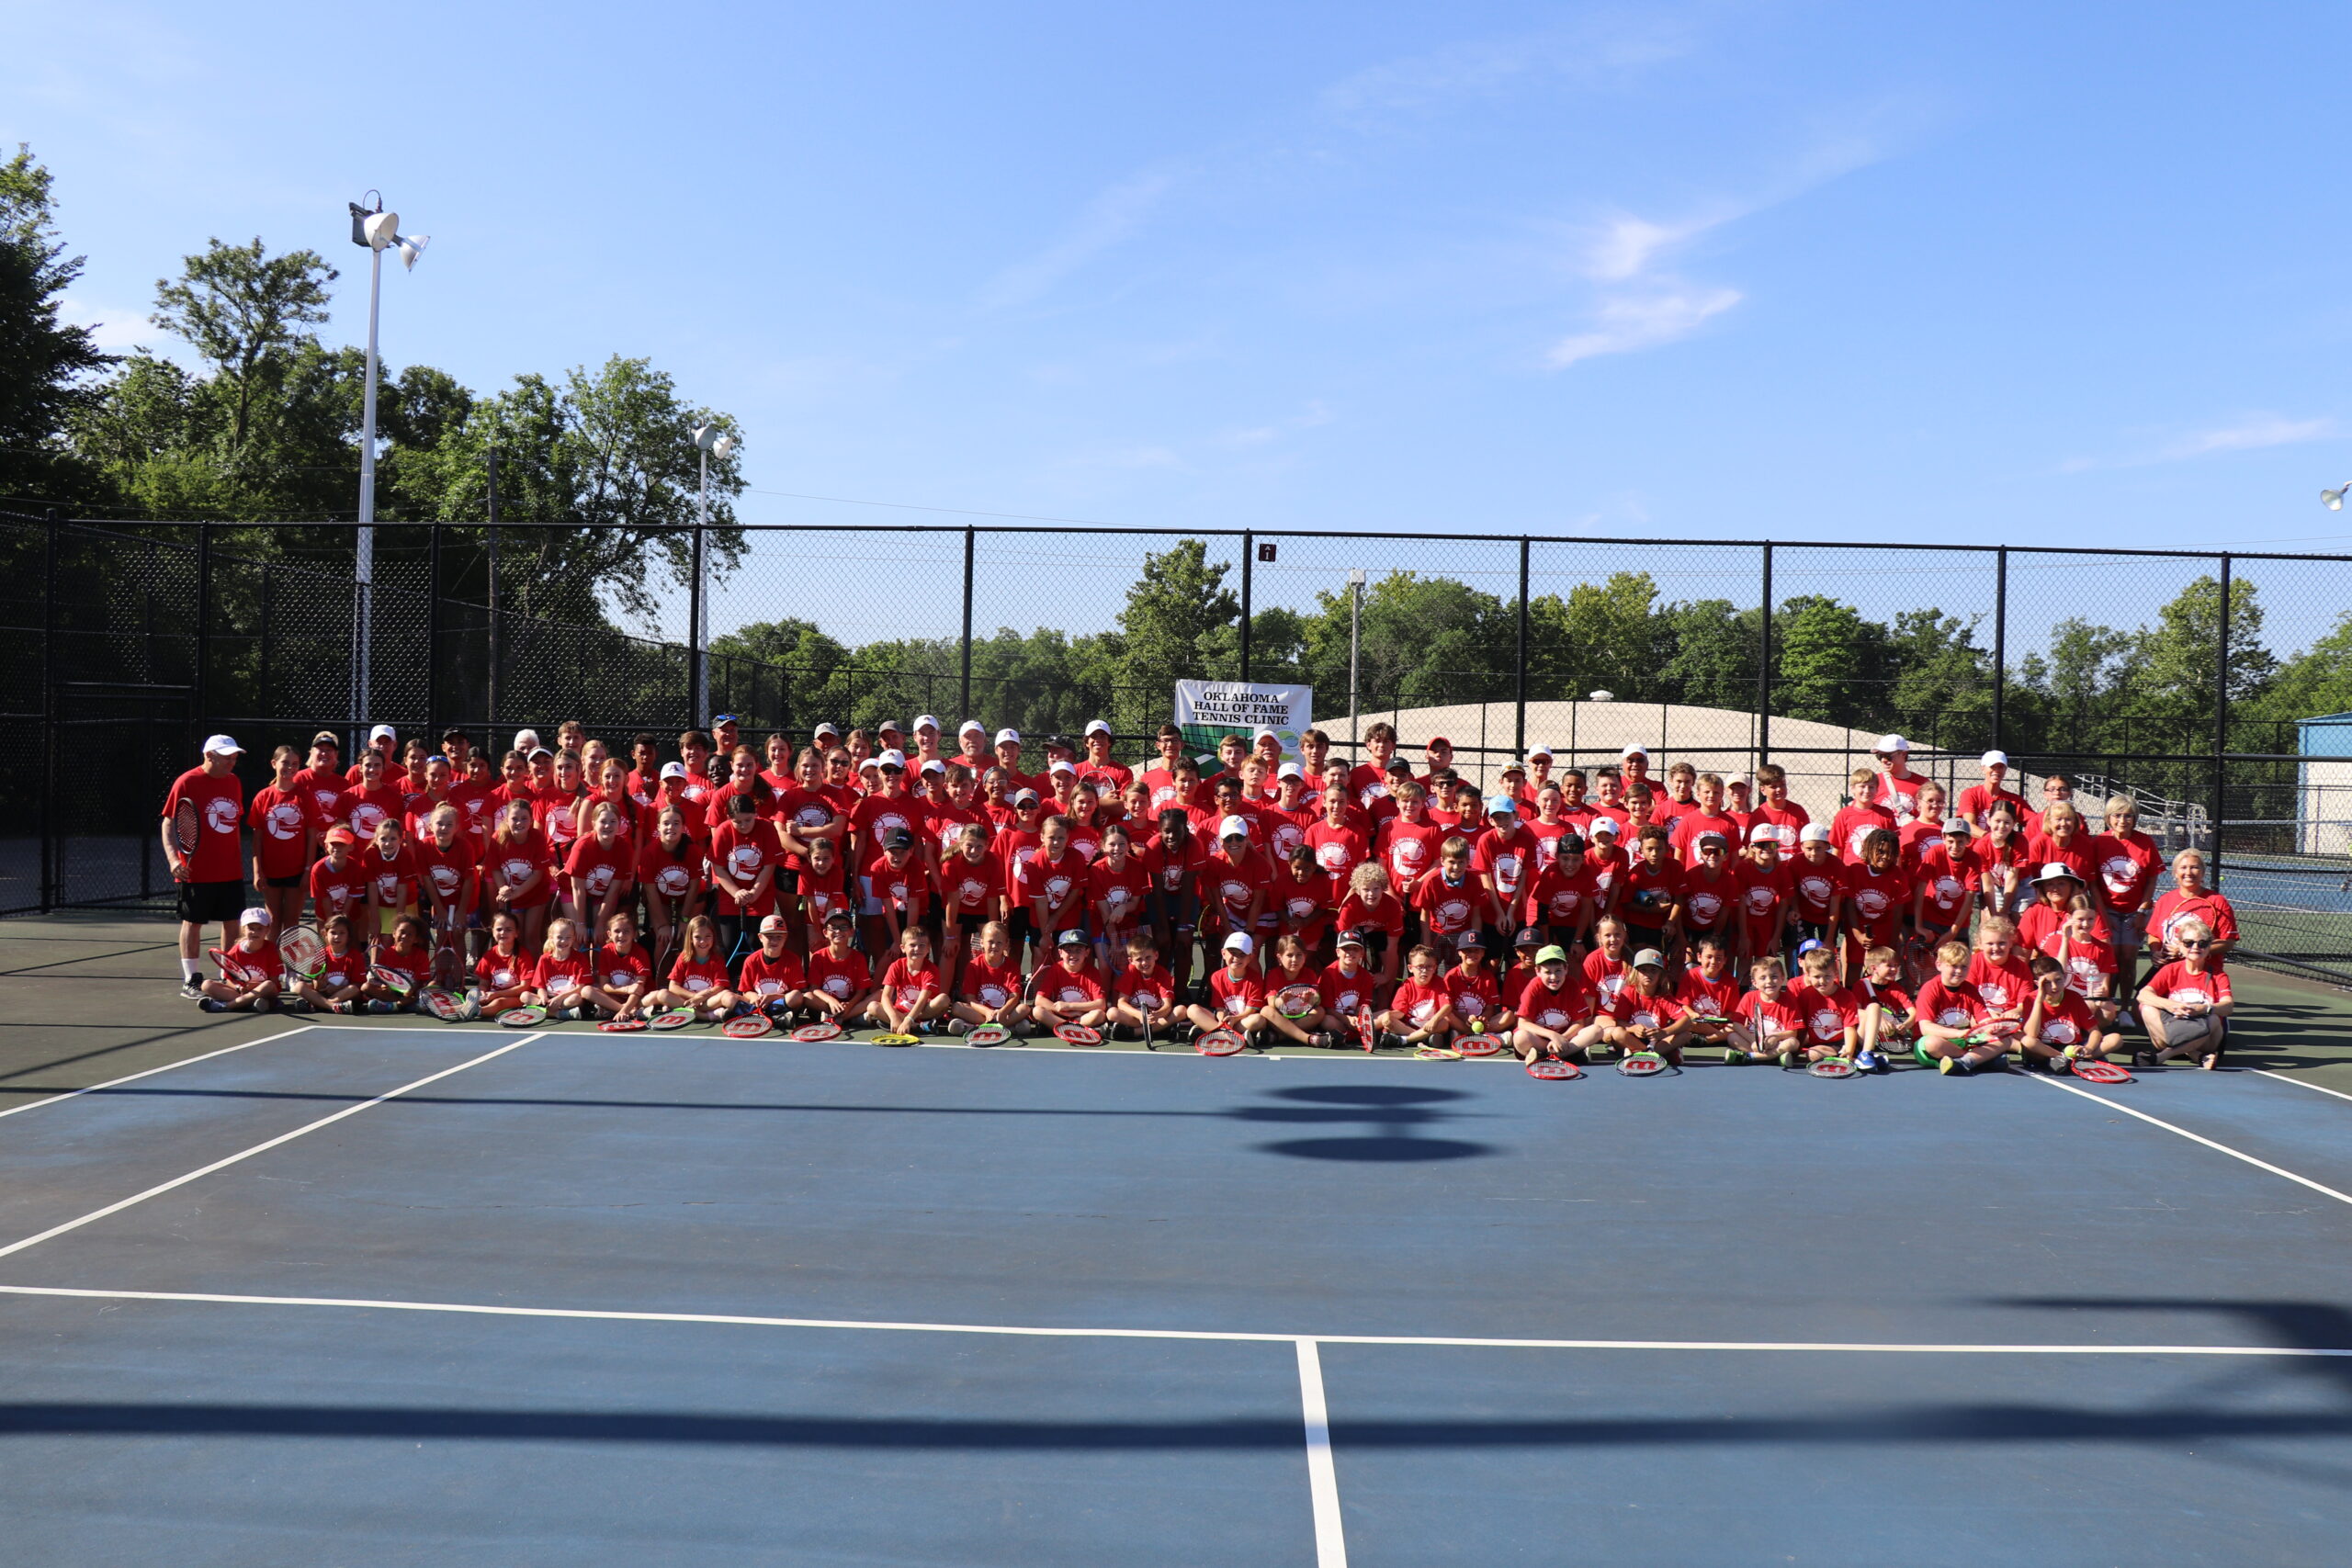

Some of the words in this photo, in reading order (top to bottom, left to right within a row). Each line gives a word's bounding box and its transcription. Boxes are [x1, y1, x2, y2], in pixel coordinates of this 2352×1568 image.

[1204, 692, 1279, 704] OKLAHOMA
[1194, 701, 1228, 712] HALL
[1232, 704, 1249, 713] OF
[1253, 704, 1288, 715] FAME
[1193, 712, 1241, 723] TENNIS
[1245, 714, 1289, 726] CLINIC
[776, 919, 783, 928] 2
[1468, 932, 1476, 942] C
[1523, 931, 1532, 941] C
